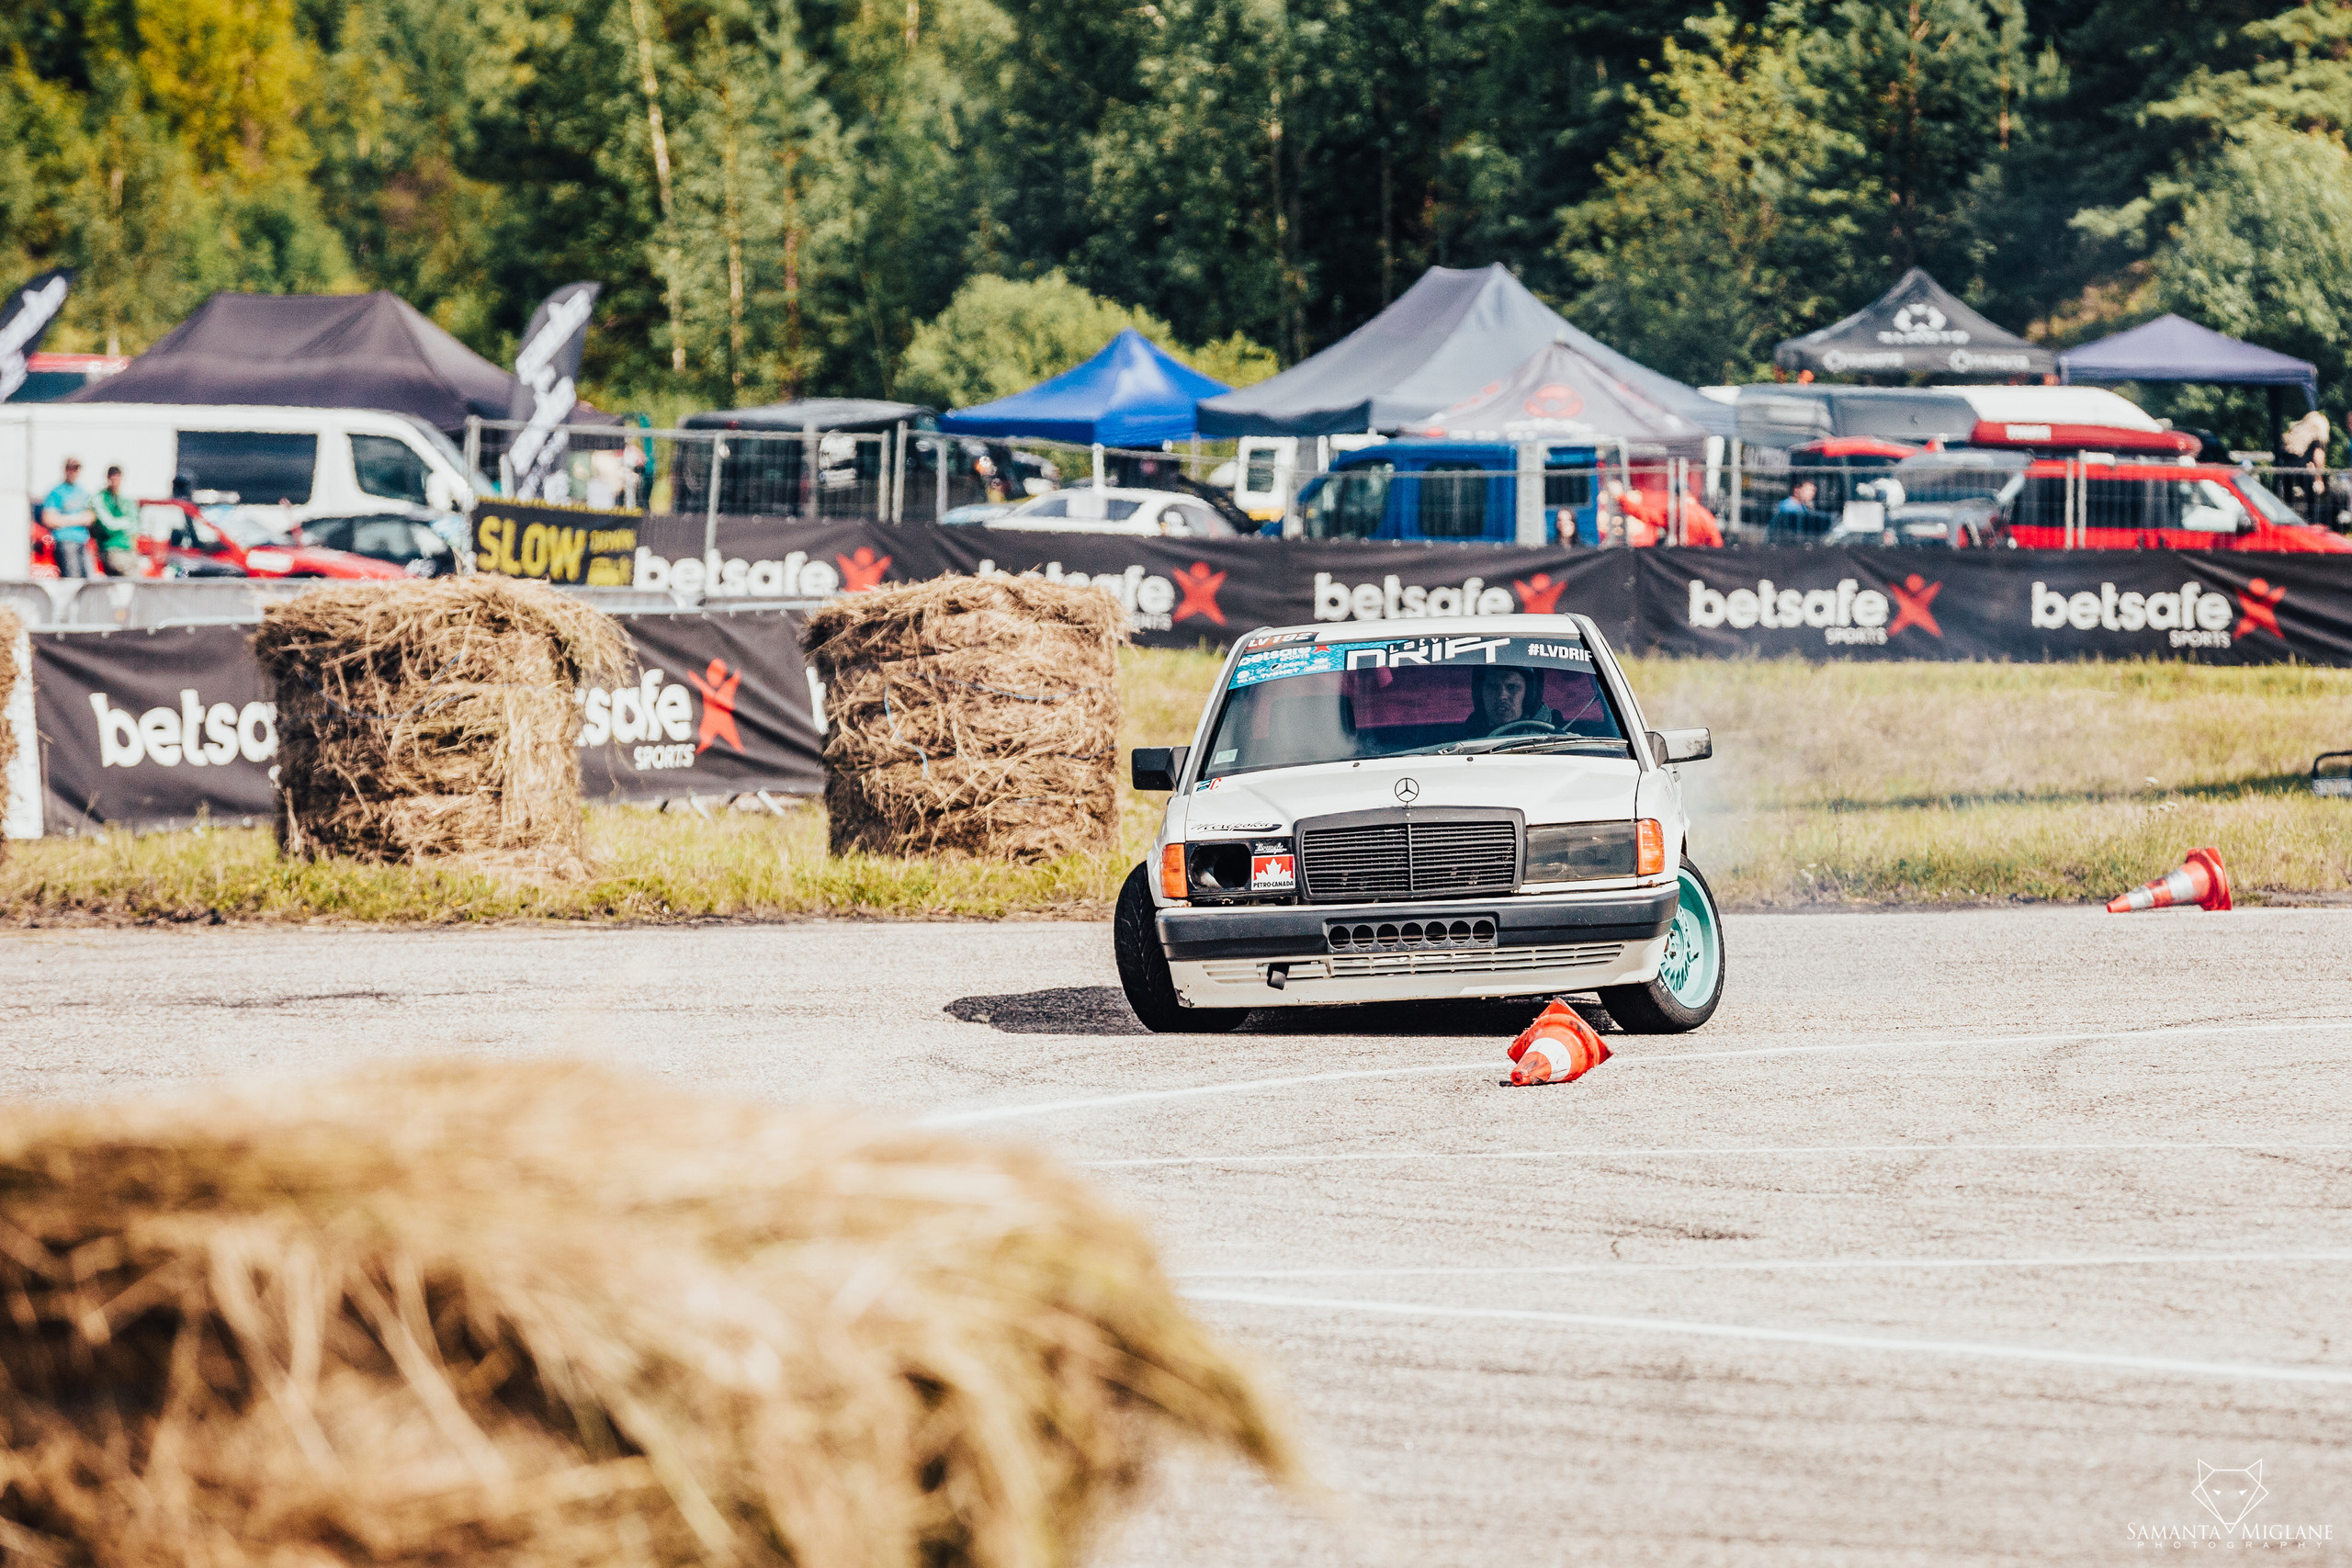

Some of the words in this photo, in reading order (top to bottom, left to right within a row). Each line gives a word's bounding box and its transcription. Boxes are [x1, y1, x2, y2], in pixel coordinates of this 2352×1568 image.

[477, 515, 588, 583] SLOW
[632, 546, 839, 597] betsafe
[1314, 571, 1515, 621] betsafe
[1689, 578, 1890, 629] betsafe
[2031, 581, 2233, 632] betsafe
[1825, 626, 1889, 646] SPORTS
[2168, 629, 2232, 649] SPORTS
[89, 689, 278, 768] betsa
[633, 743, 696, 772] SPORTS
